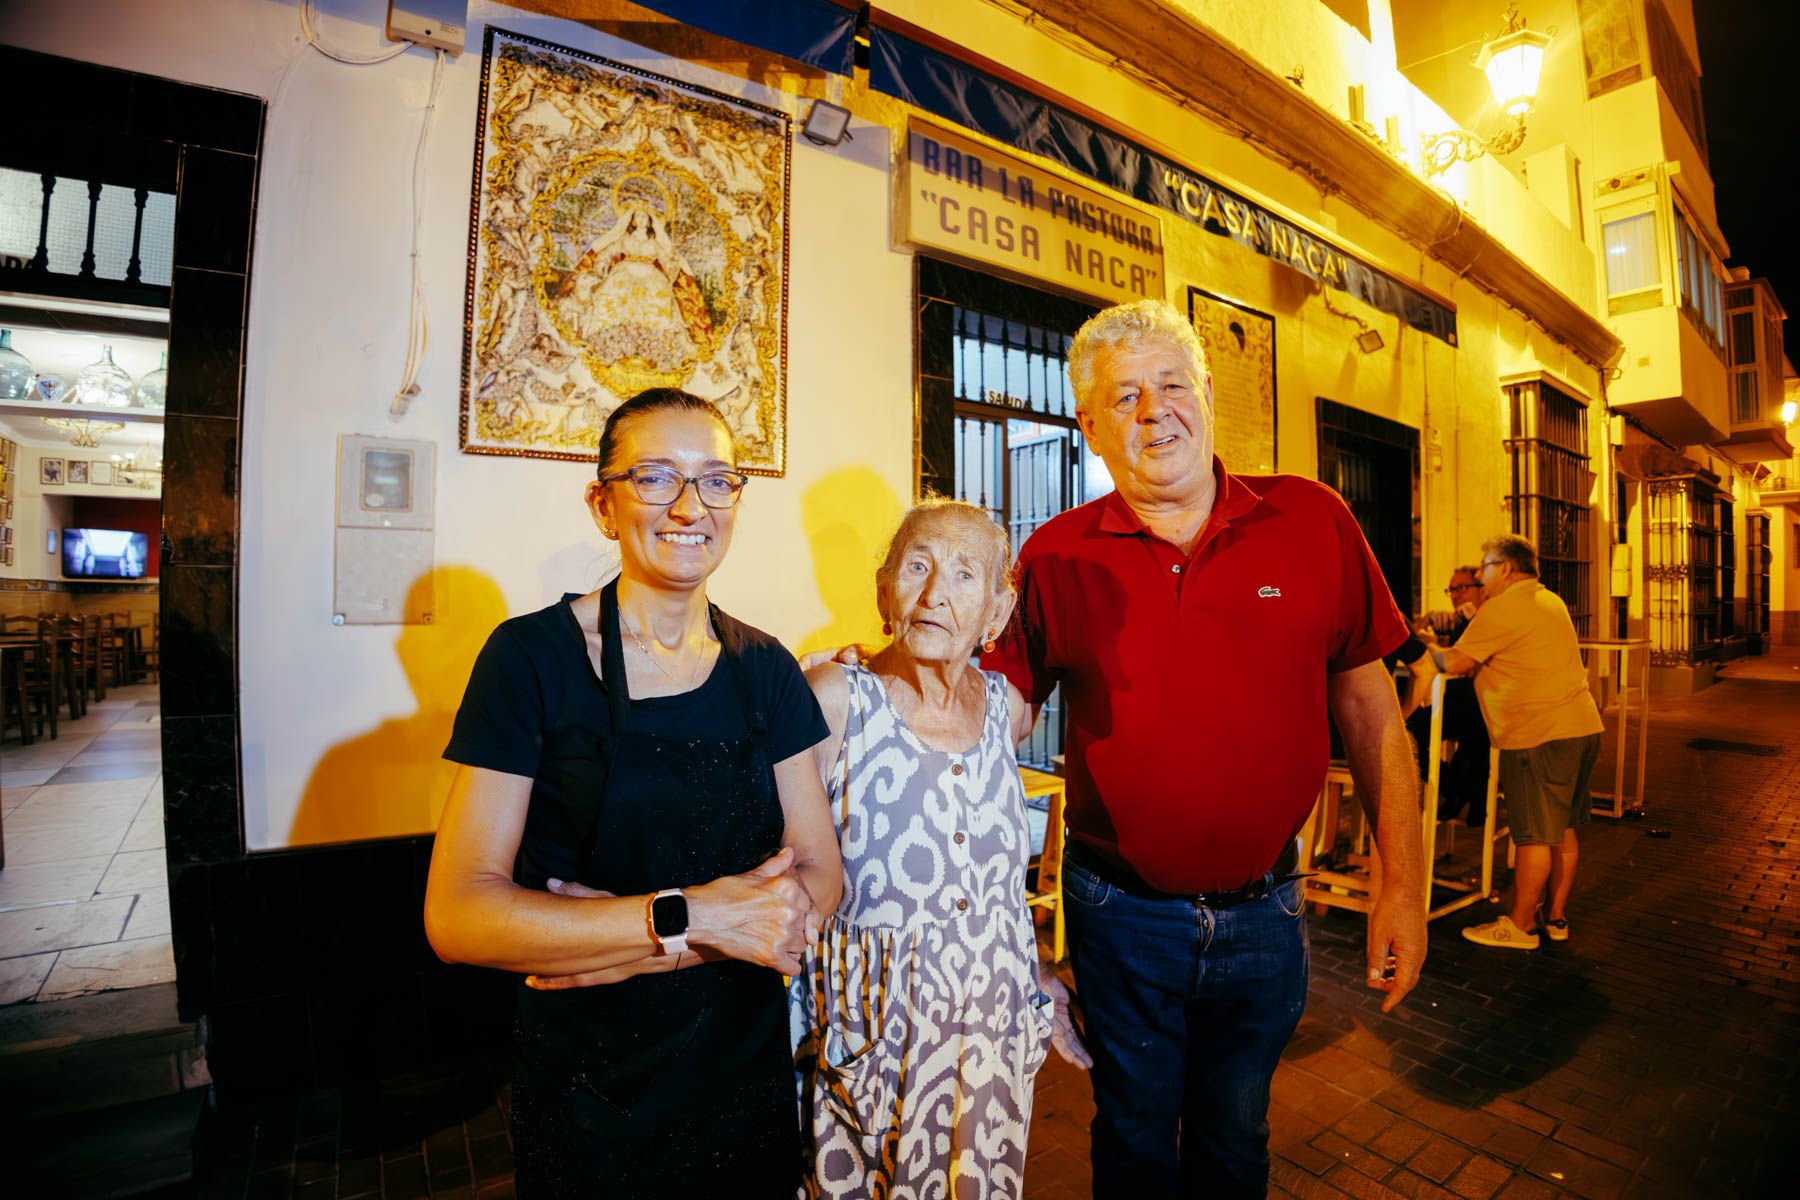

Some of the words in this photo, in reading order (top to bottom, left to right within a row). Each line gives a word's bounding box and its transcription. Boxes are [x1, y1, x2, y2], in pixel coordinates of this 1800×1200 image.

[920, 189, 1040, 261] "CASA
[1065, 239, 1157, 296] NACA"
[922, 137, 983, 192] BAR
[998, 168, 1035, 210] LA
[1048, 187, 1154, 255] PASTORA
[1164, 170, 1261, 246] "CASA
[1271, 222, 1347, 283] NACA"
